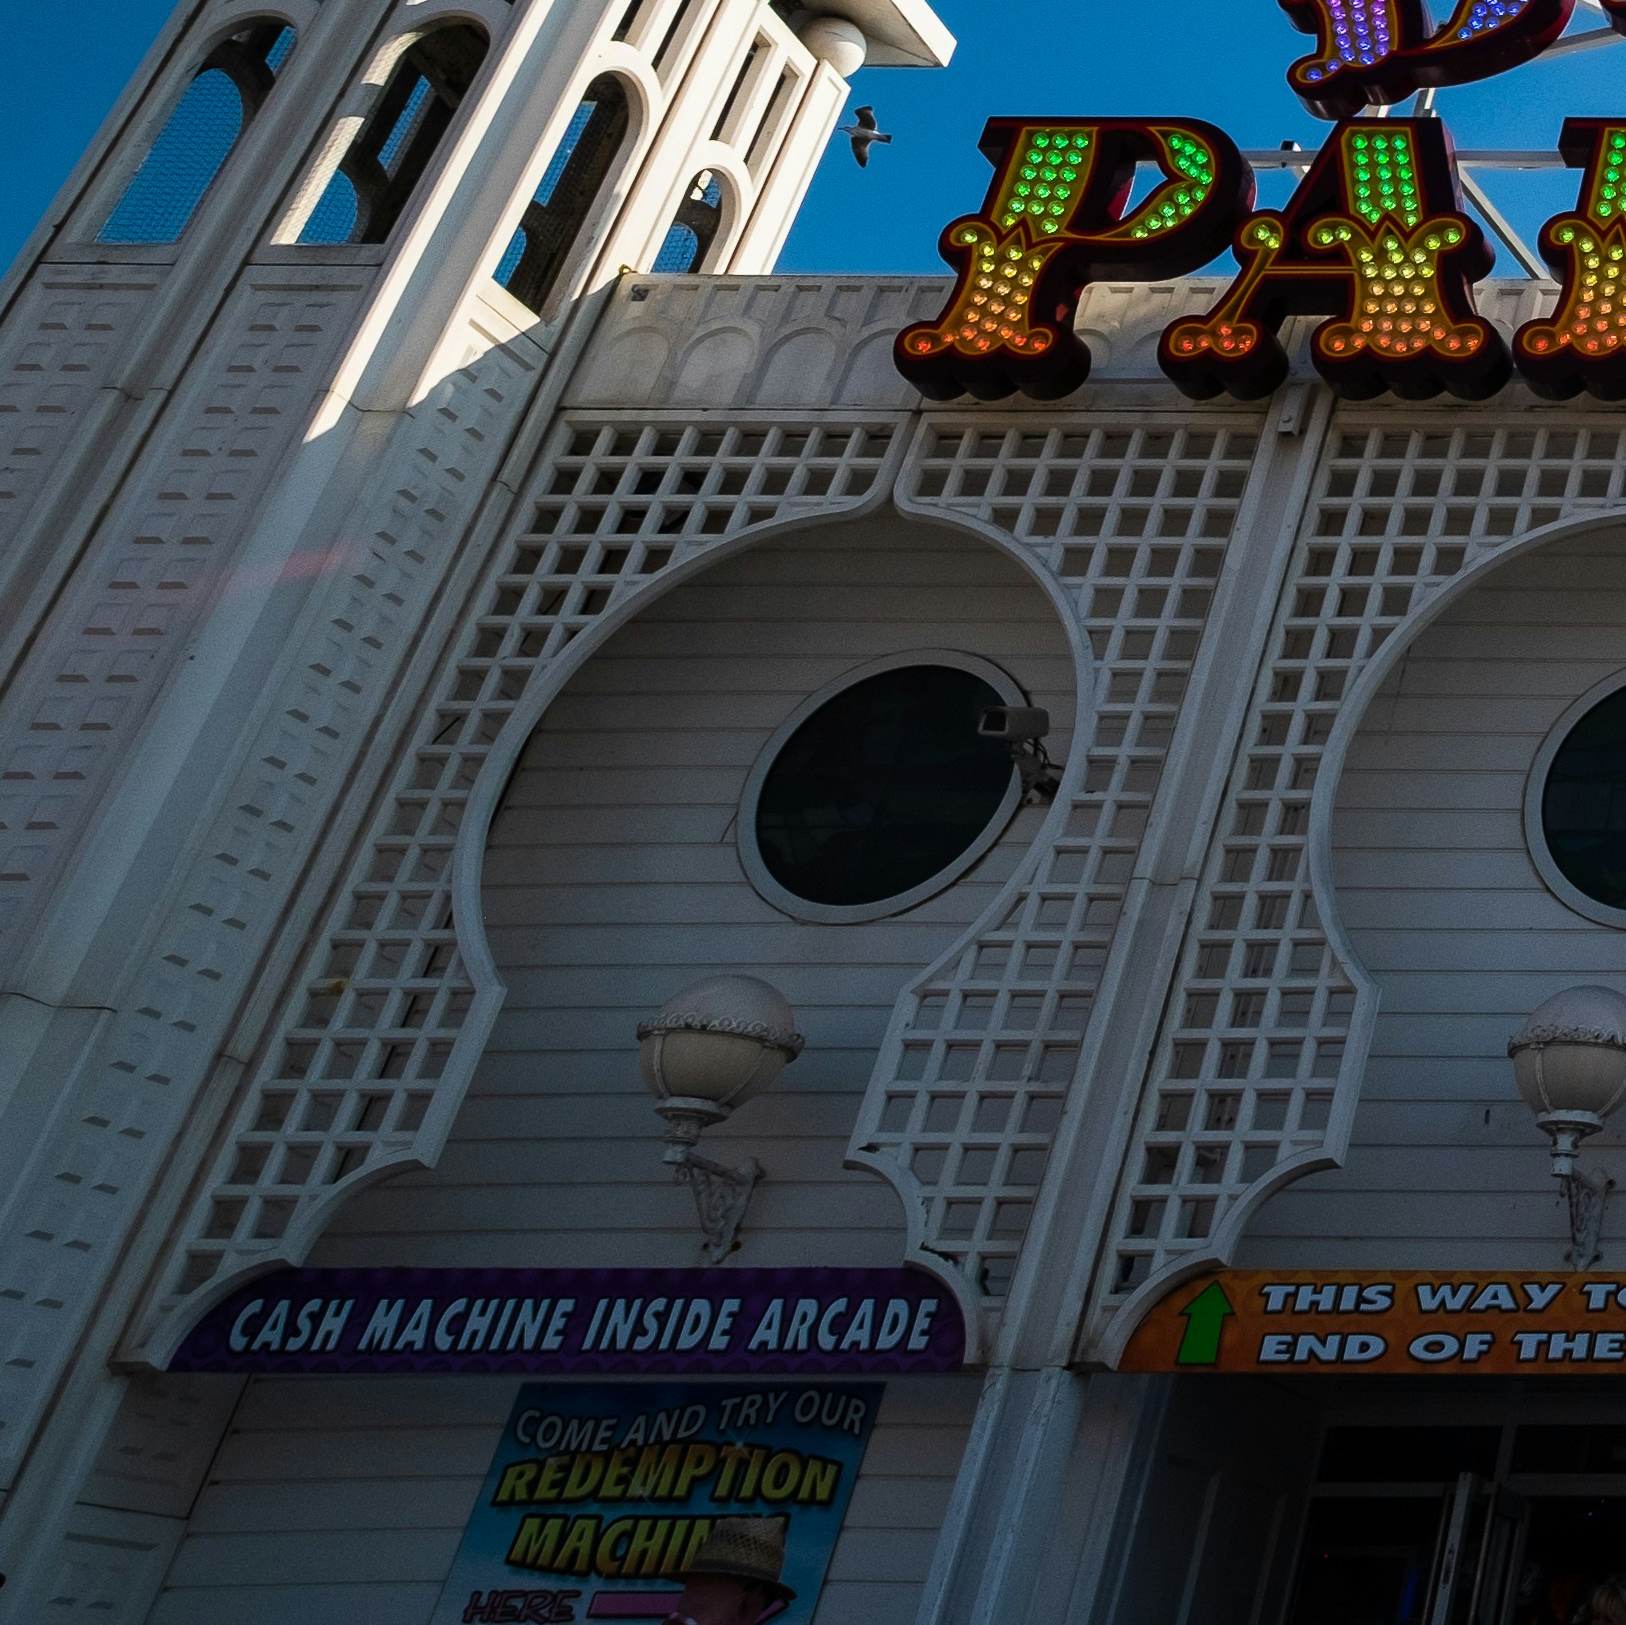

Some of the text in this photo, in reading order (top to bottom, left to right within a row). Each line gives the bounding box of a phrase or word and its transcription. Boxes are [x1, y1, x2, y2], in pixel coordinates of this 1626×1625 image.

[1259, 1283, 1394, 1314] THIS
[1416, 1283, 1564, 1314] WAY
[228, 1297, 938, 1353] CASH MACHINE INSIDE ARCADE
[1257, 1332, 1387, 1364] END
[1407, 1332, 1496, 1364] OF
[1514, 1332, 1626, 1363] THE
[514, 1388, 868, 1452] COME AND TRY OUR
[493, 1444, 842, 1506] REDEMPTION
[463, 1591, 581, 1624] HERE
